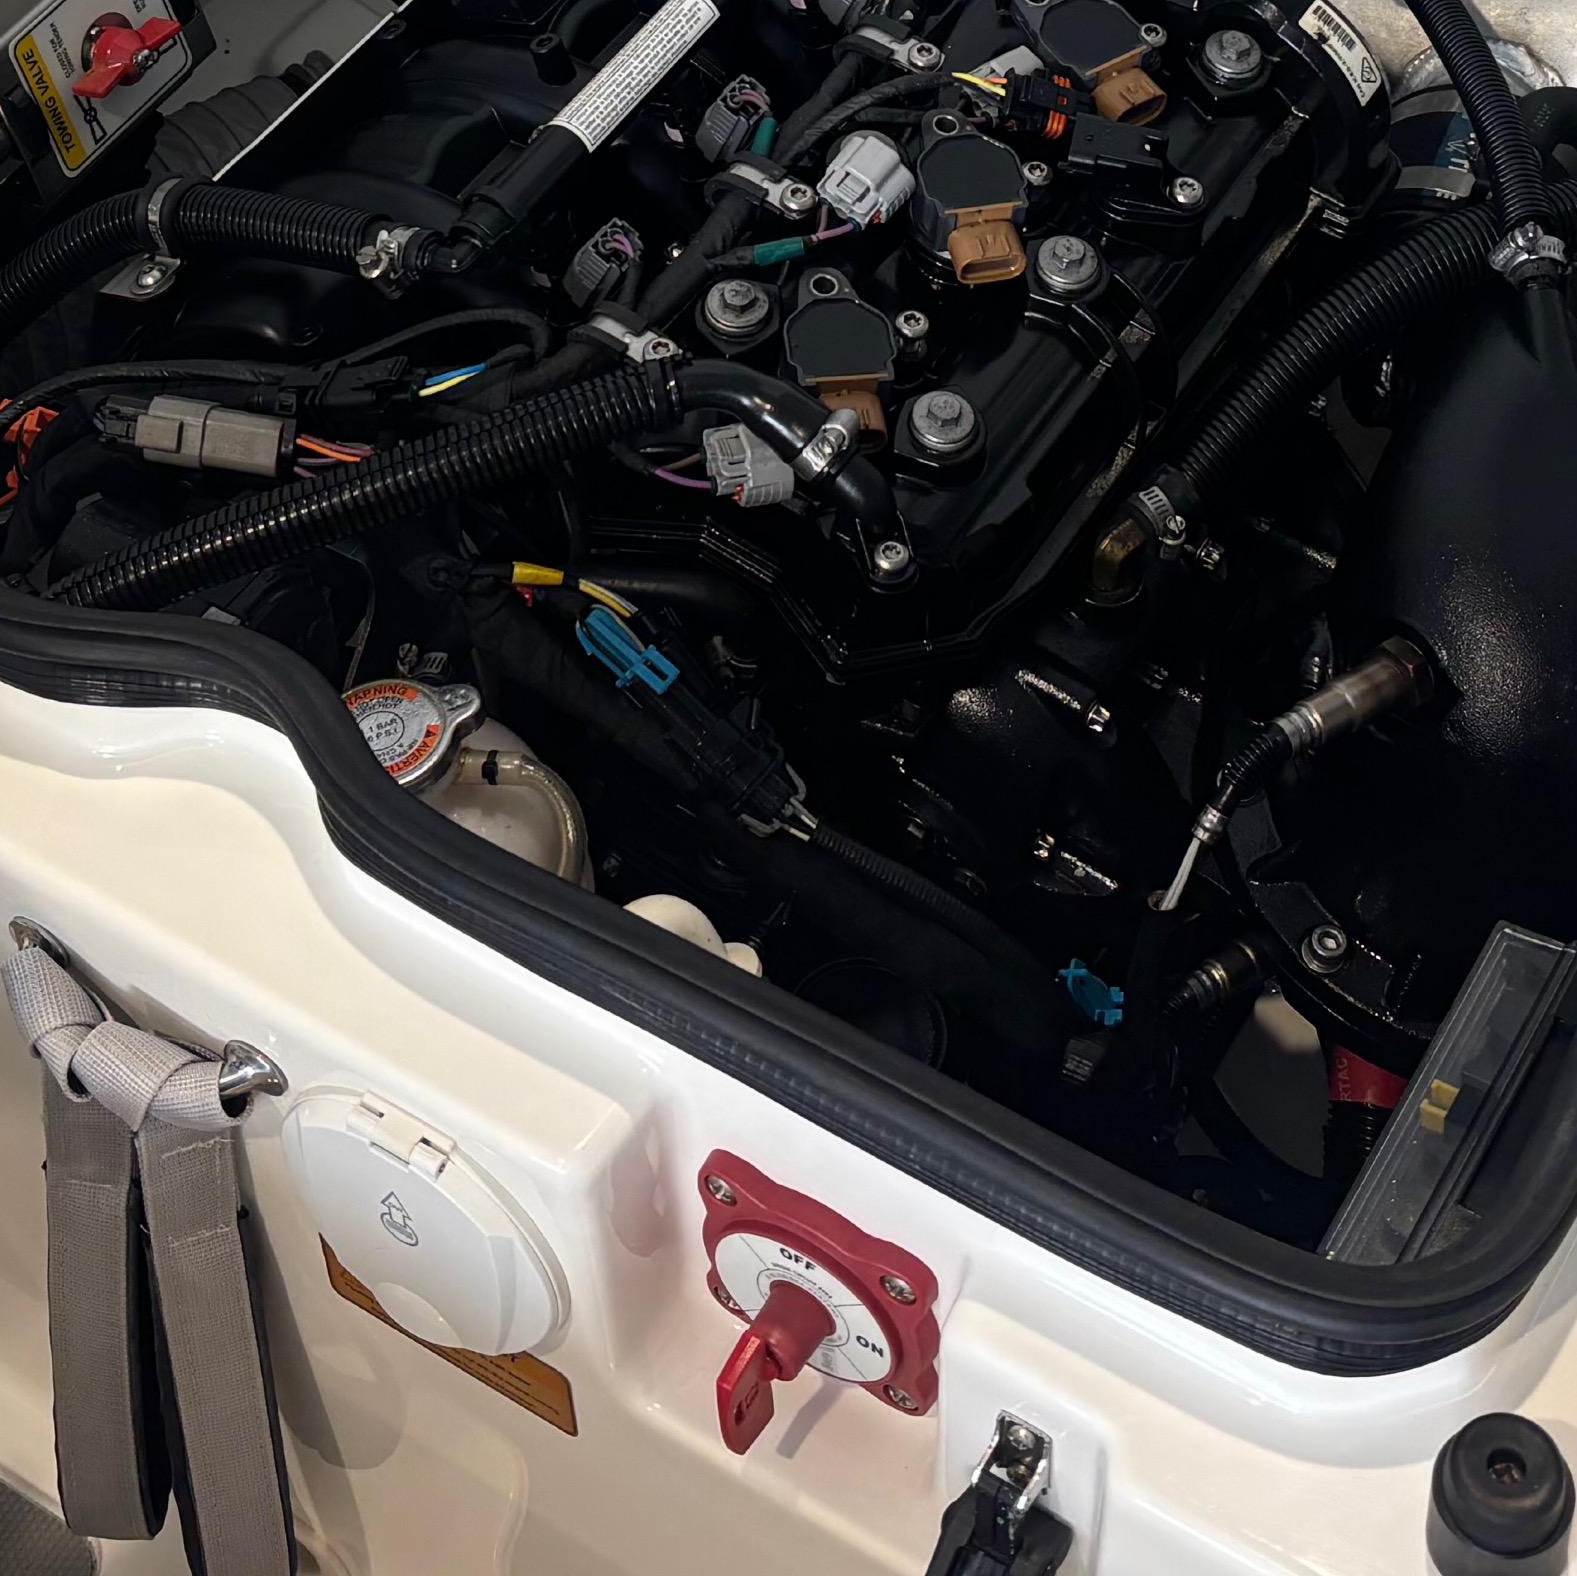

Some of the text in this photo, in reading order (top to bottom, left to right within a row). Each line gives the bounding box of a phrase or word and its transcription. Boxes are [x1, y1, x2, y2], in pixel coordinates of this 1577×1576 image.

[22, 47, 77, 154] TOWING VALVE
[779, 1247, 817, 1272] OFF
[856, 1335, 885, 1358] ON
